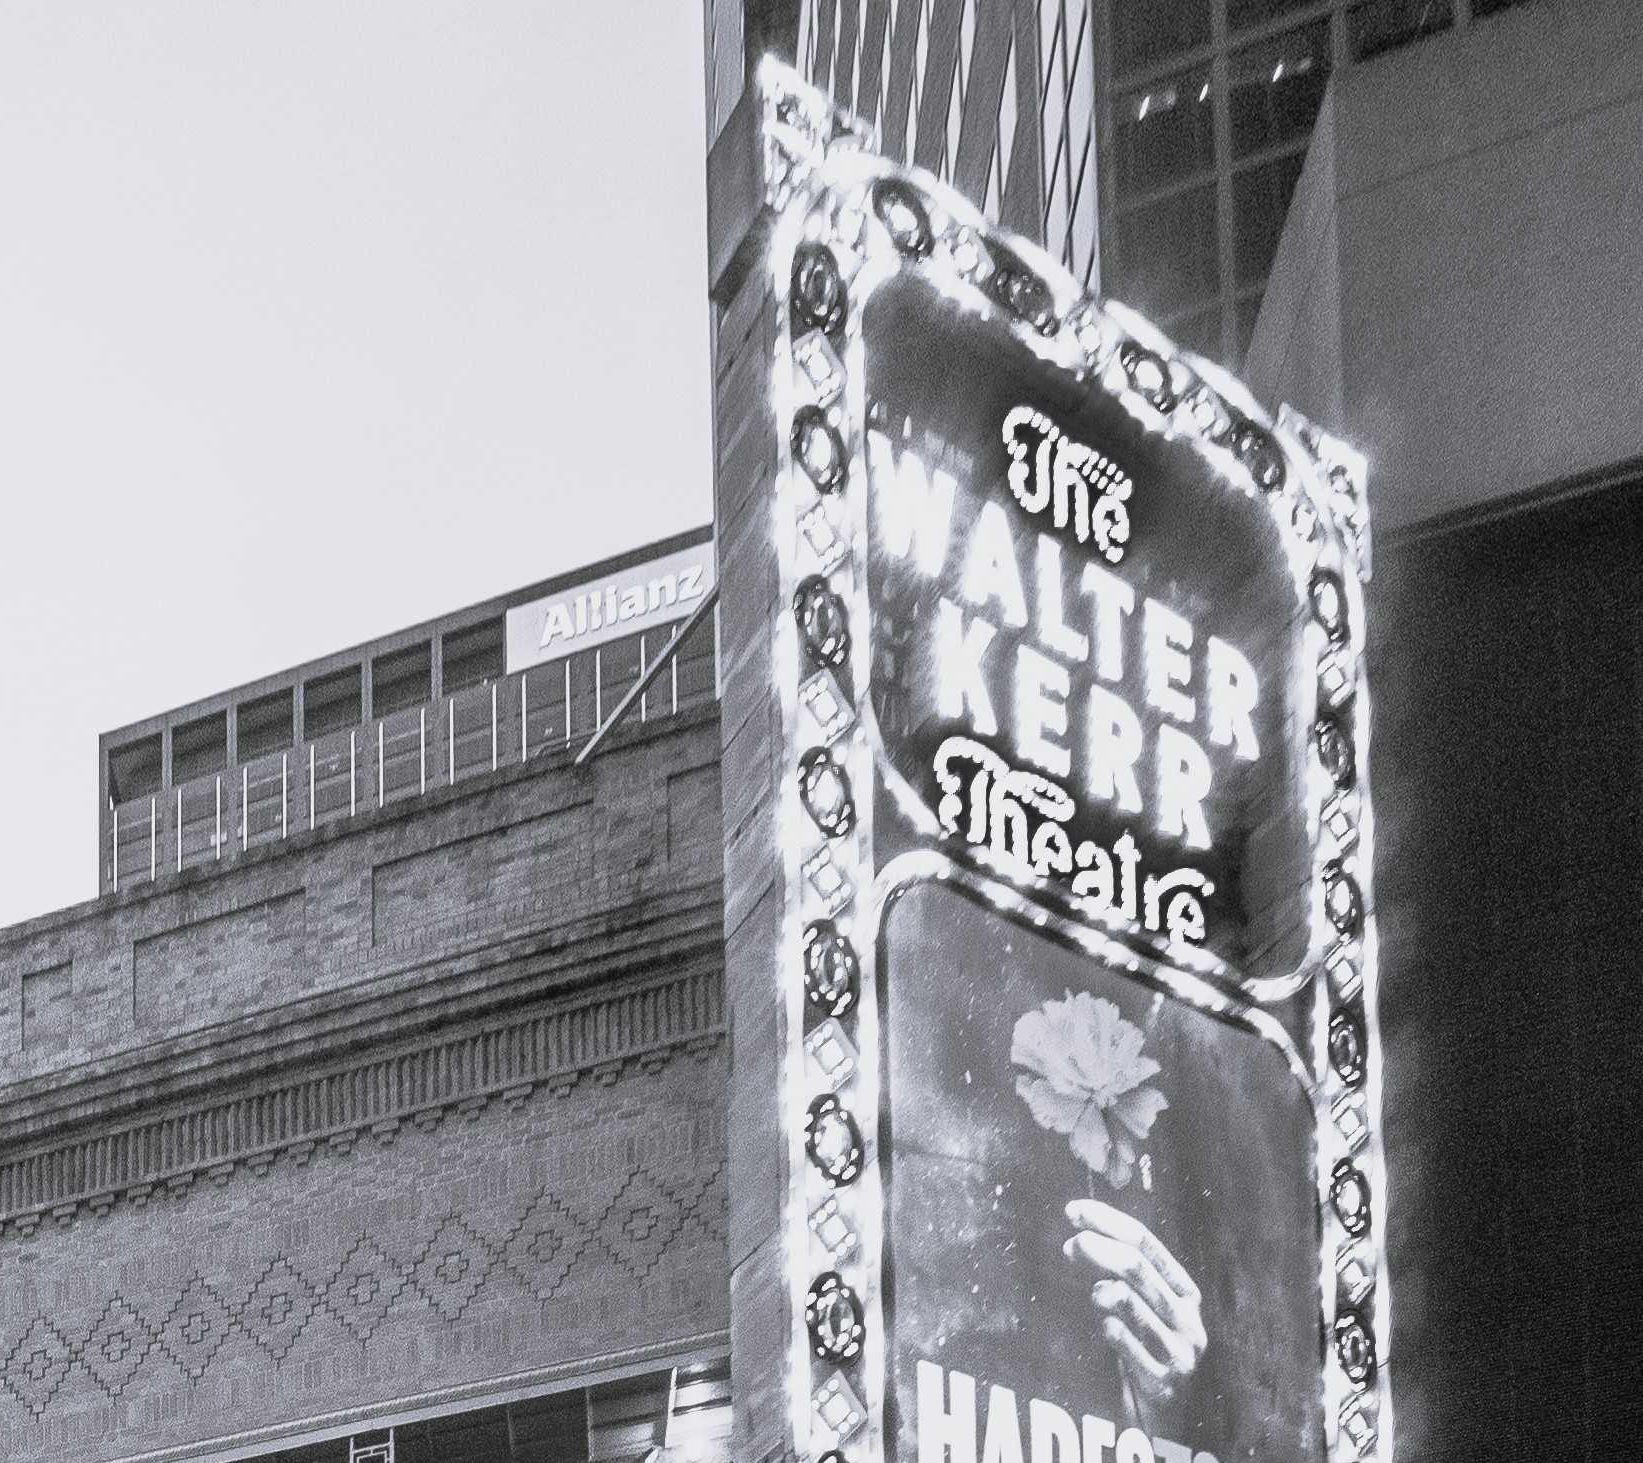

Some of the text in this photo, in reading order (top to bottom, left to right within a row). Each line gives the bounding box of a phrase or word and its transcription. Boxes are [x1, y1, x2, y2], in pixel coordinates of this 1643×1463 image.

[1002, 405, 1133, 563] The
[540, 565, 705, 650] Allianz
[867, 429, 1260, 761] WALTER
[937, 597, 1213, 849] KERR
[933, 737, 1215, 945] Theatre
